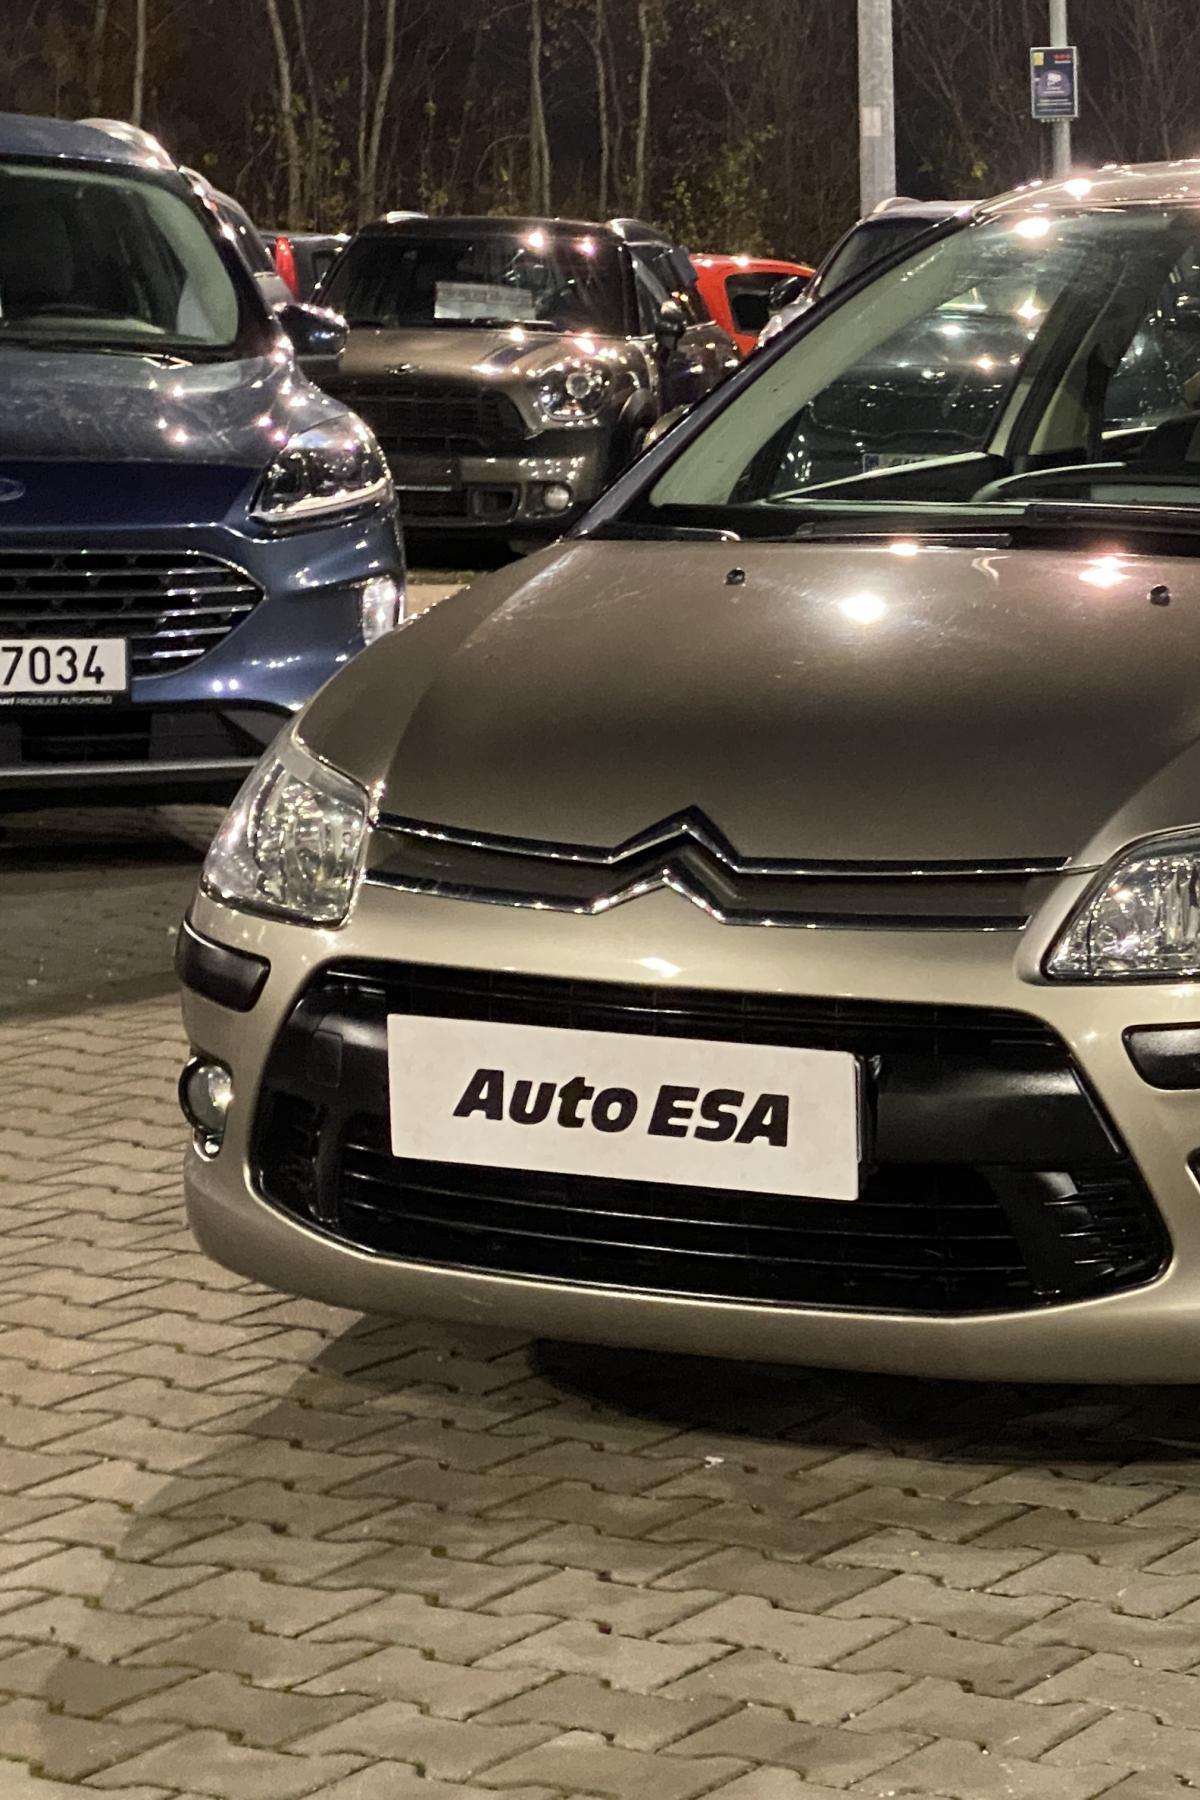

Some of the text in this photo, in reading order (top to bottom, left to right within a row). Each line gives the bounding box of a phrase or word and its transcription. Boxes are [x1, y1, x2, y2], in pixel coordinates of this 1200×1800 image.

[2, 645, 105, 685] 7034
[453, 1069, 790, 1148] Auto ESA
